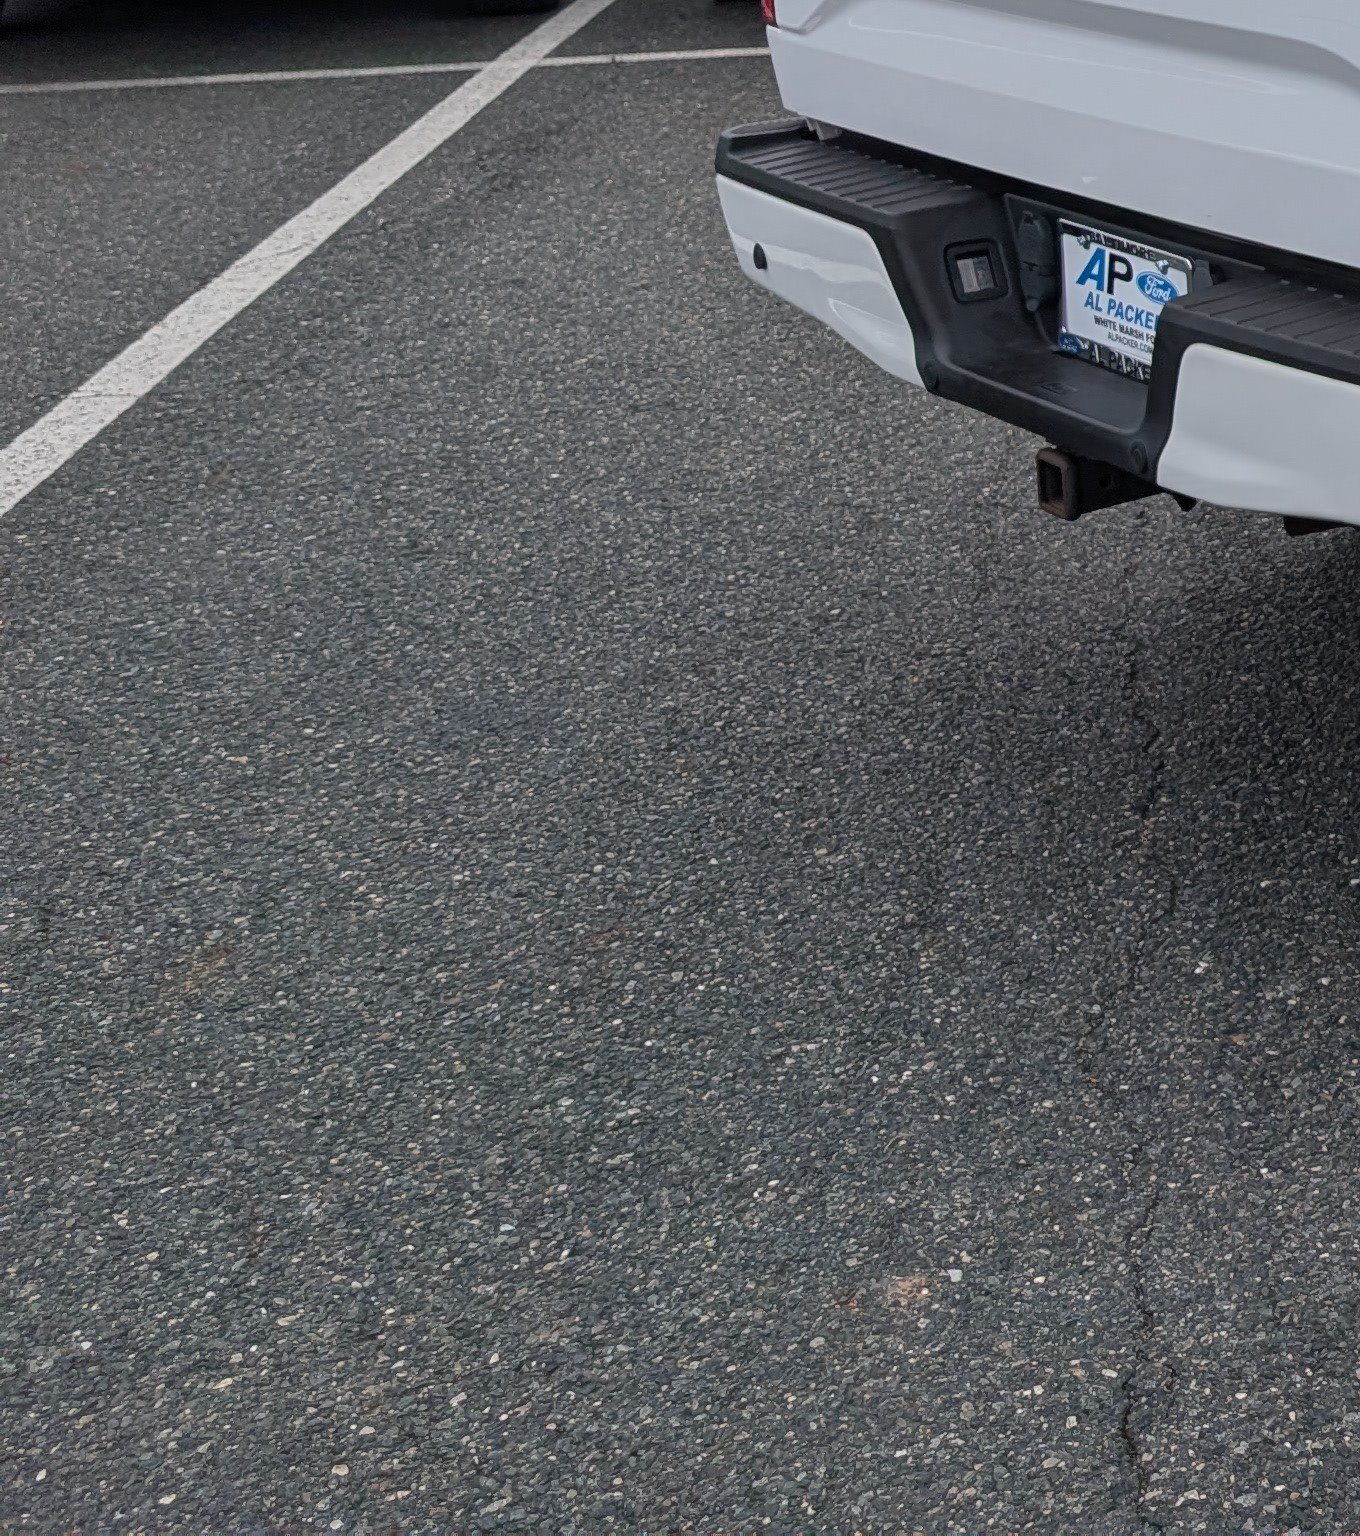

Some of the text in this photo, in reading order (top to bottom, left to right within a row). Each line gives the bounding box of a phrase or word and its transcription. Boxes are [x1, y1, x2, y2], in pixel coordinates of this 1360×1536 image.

[1076, 247, 1134, 295] AP
[1145, 275, 1171, 301] Ford
[1084, 291, 1103, 312] AL
[1094, 315, 1117, 331] WHITE
[1119, 324, 1144, 341] MARSH
[1109, 350, 1151, 381] PACKE
